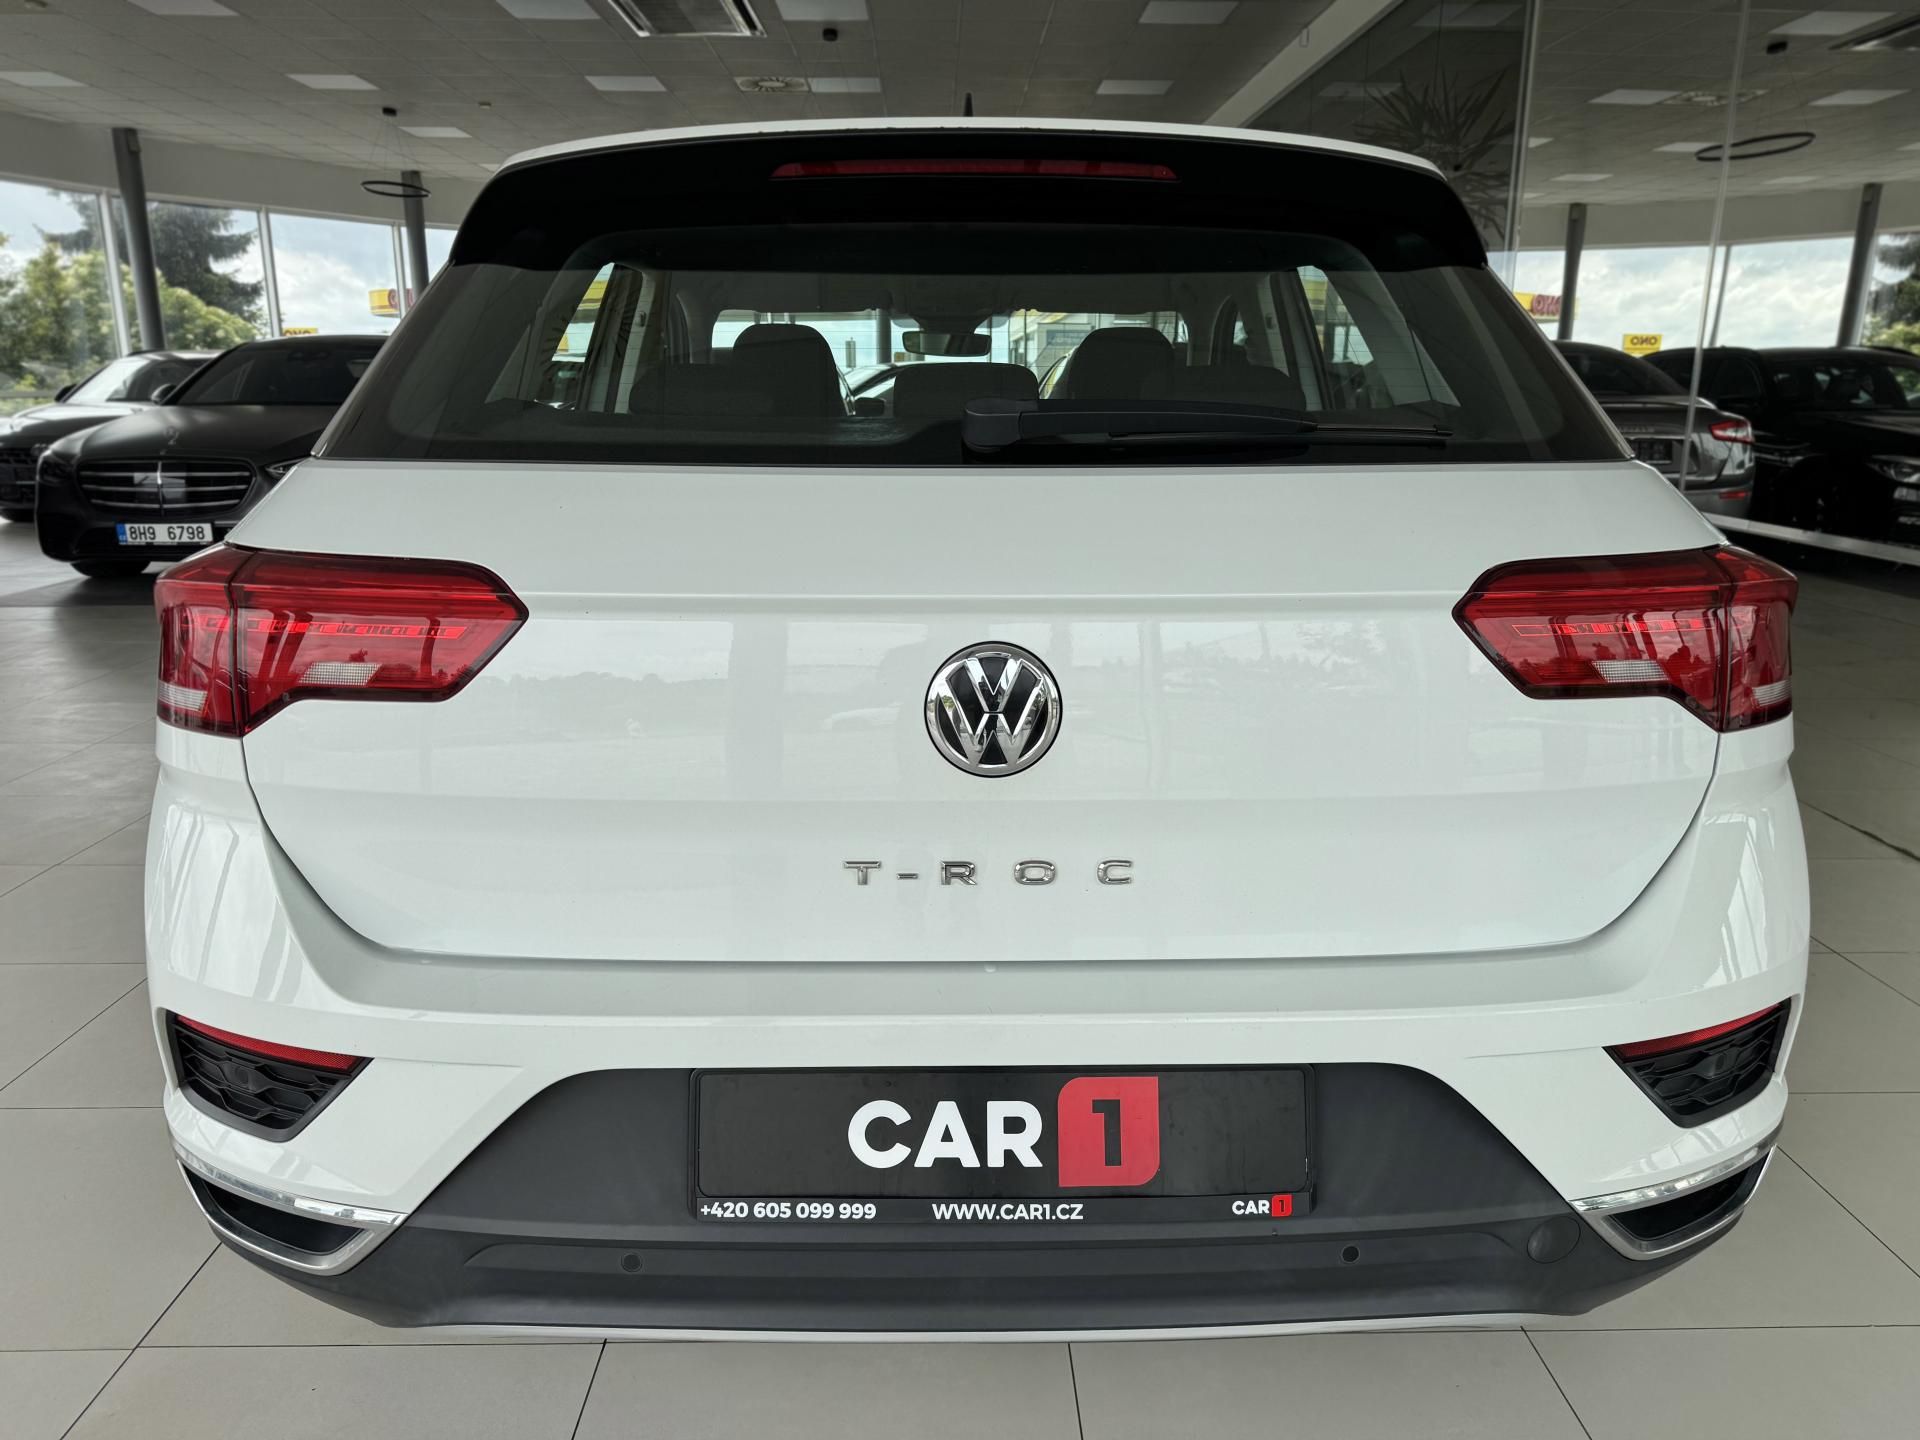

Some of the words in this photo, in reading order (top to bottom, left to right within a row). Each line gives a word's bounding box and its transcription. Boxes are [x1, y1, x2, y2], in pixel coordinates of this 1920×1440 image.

[129, 526, 156, 541] 8H9
[167, 526, 205, 541] 6798
[933, 650, 1053, 770] VW
[843, 859, 1134, 886] T-ROC
[700, 1202, 749, 1219] +420
[753, 1202, 792, 1219] 605
[796, 1203, 835, 1219] 099
[839, 1203, 877, 1219] 999
[932, 1203, 1084, 1220] WWW.CAR1.CZ
